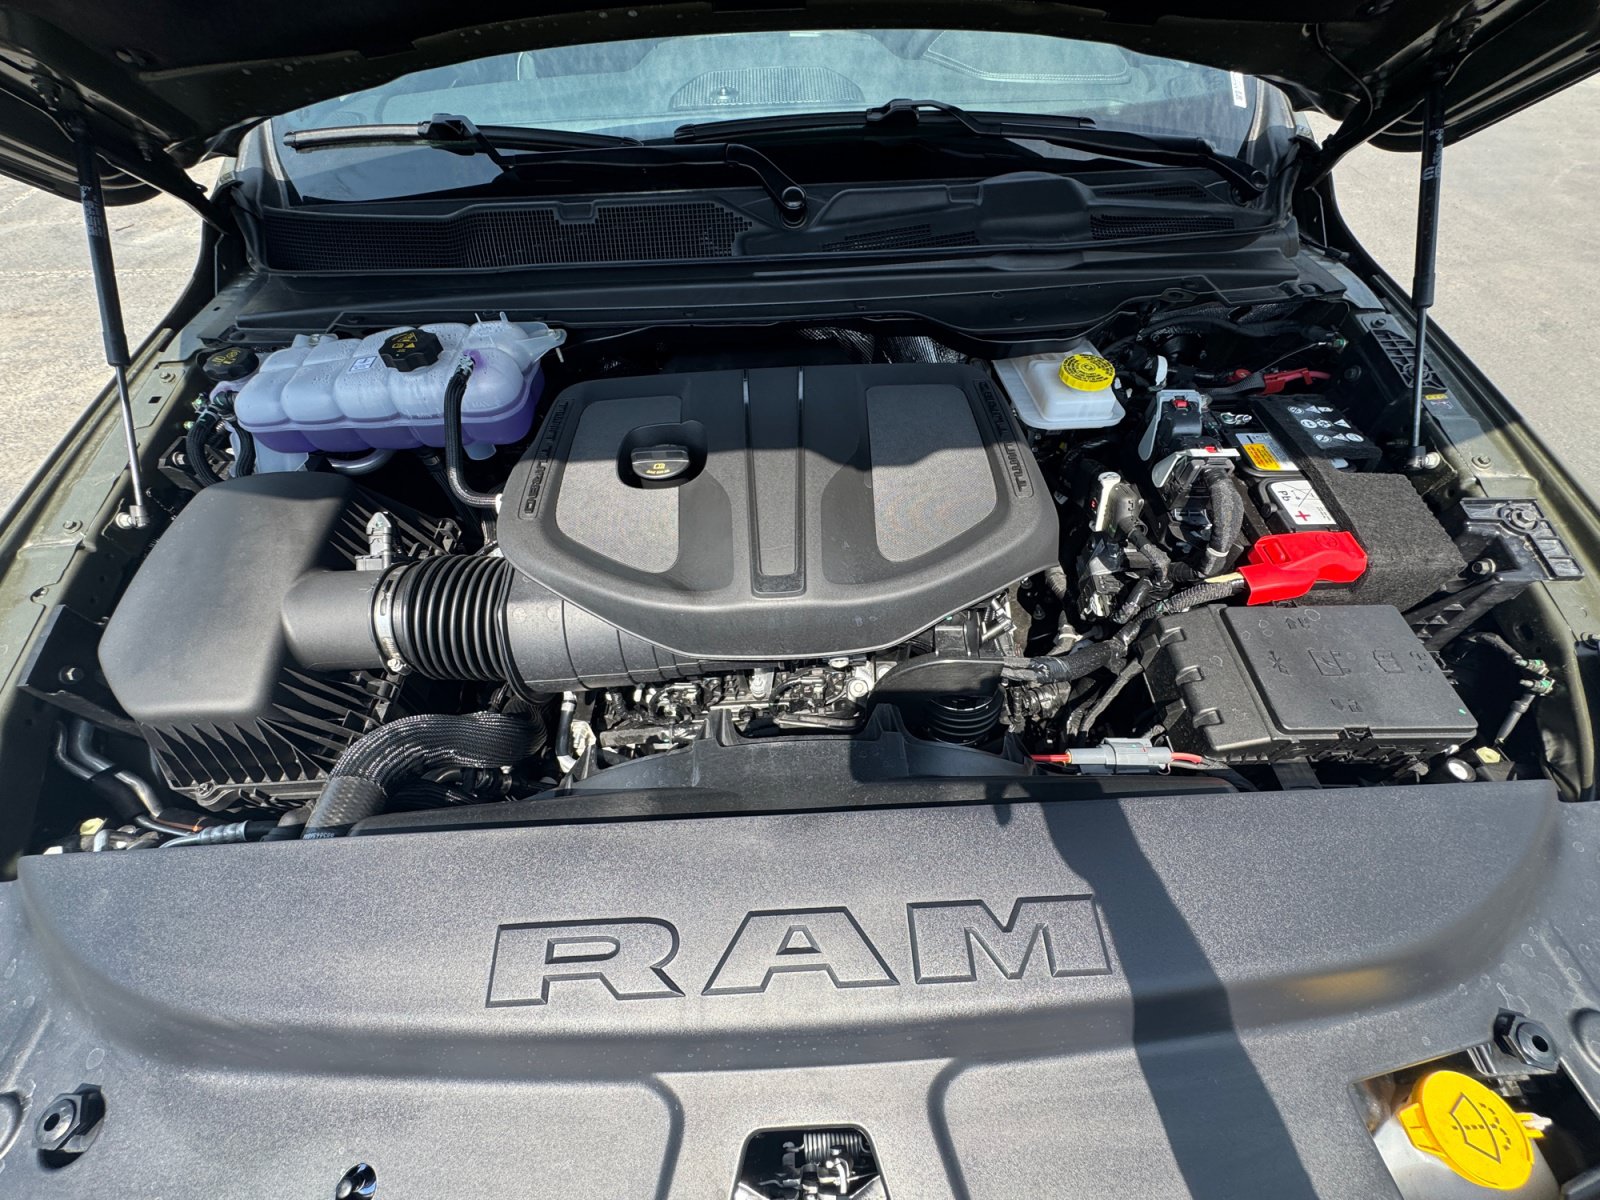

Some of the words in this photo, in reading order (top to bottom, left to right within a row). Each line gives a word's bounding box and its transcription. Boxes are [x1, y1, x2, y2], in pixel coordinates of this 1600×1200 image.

[524, 445, 553, 514] TURBO
[1278, 489, 1292, 502] Pb
[486, 894, 1112, 1009] RAM
